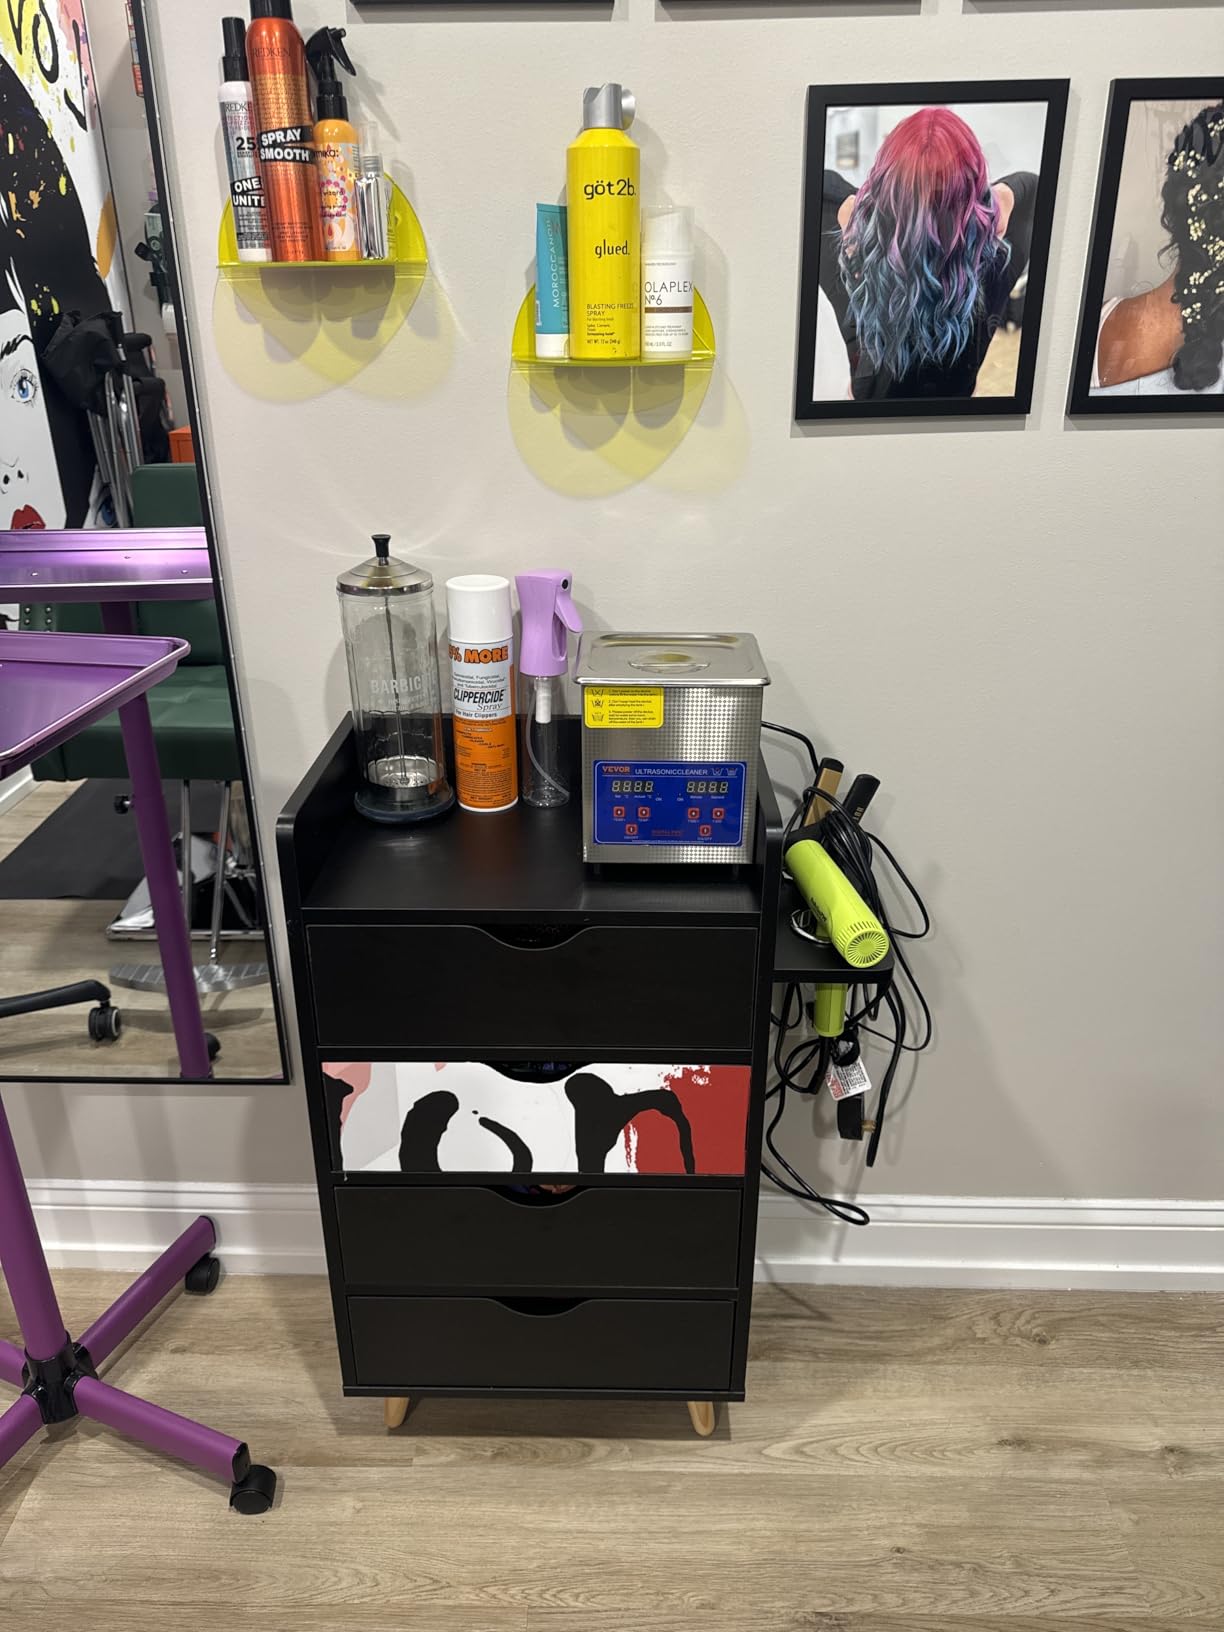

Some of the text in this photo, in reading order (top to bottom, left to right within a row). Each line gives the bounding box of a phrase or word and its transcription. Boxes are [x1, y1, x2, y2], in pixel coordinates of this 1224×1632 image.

[235, 136, 257, 151] 25
[261, 128, 302, 146] SPRAY
[260, 147, 310, 161] SMOOTH
[234, 177, 261, 193] ONE
[644, 281, 693, 293] OLAPLEX
[464, 646, 509, 664] MORE
[453, 687, 506, 704] CLIPPERCIDE
[477, 702, 503, 712] Spray
[602, 765, 631, 773] VEVOR
